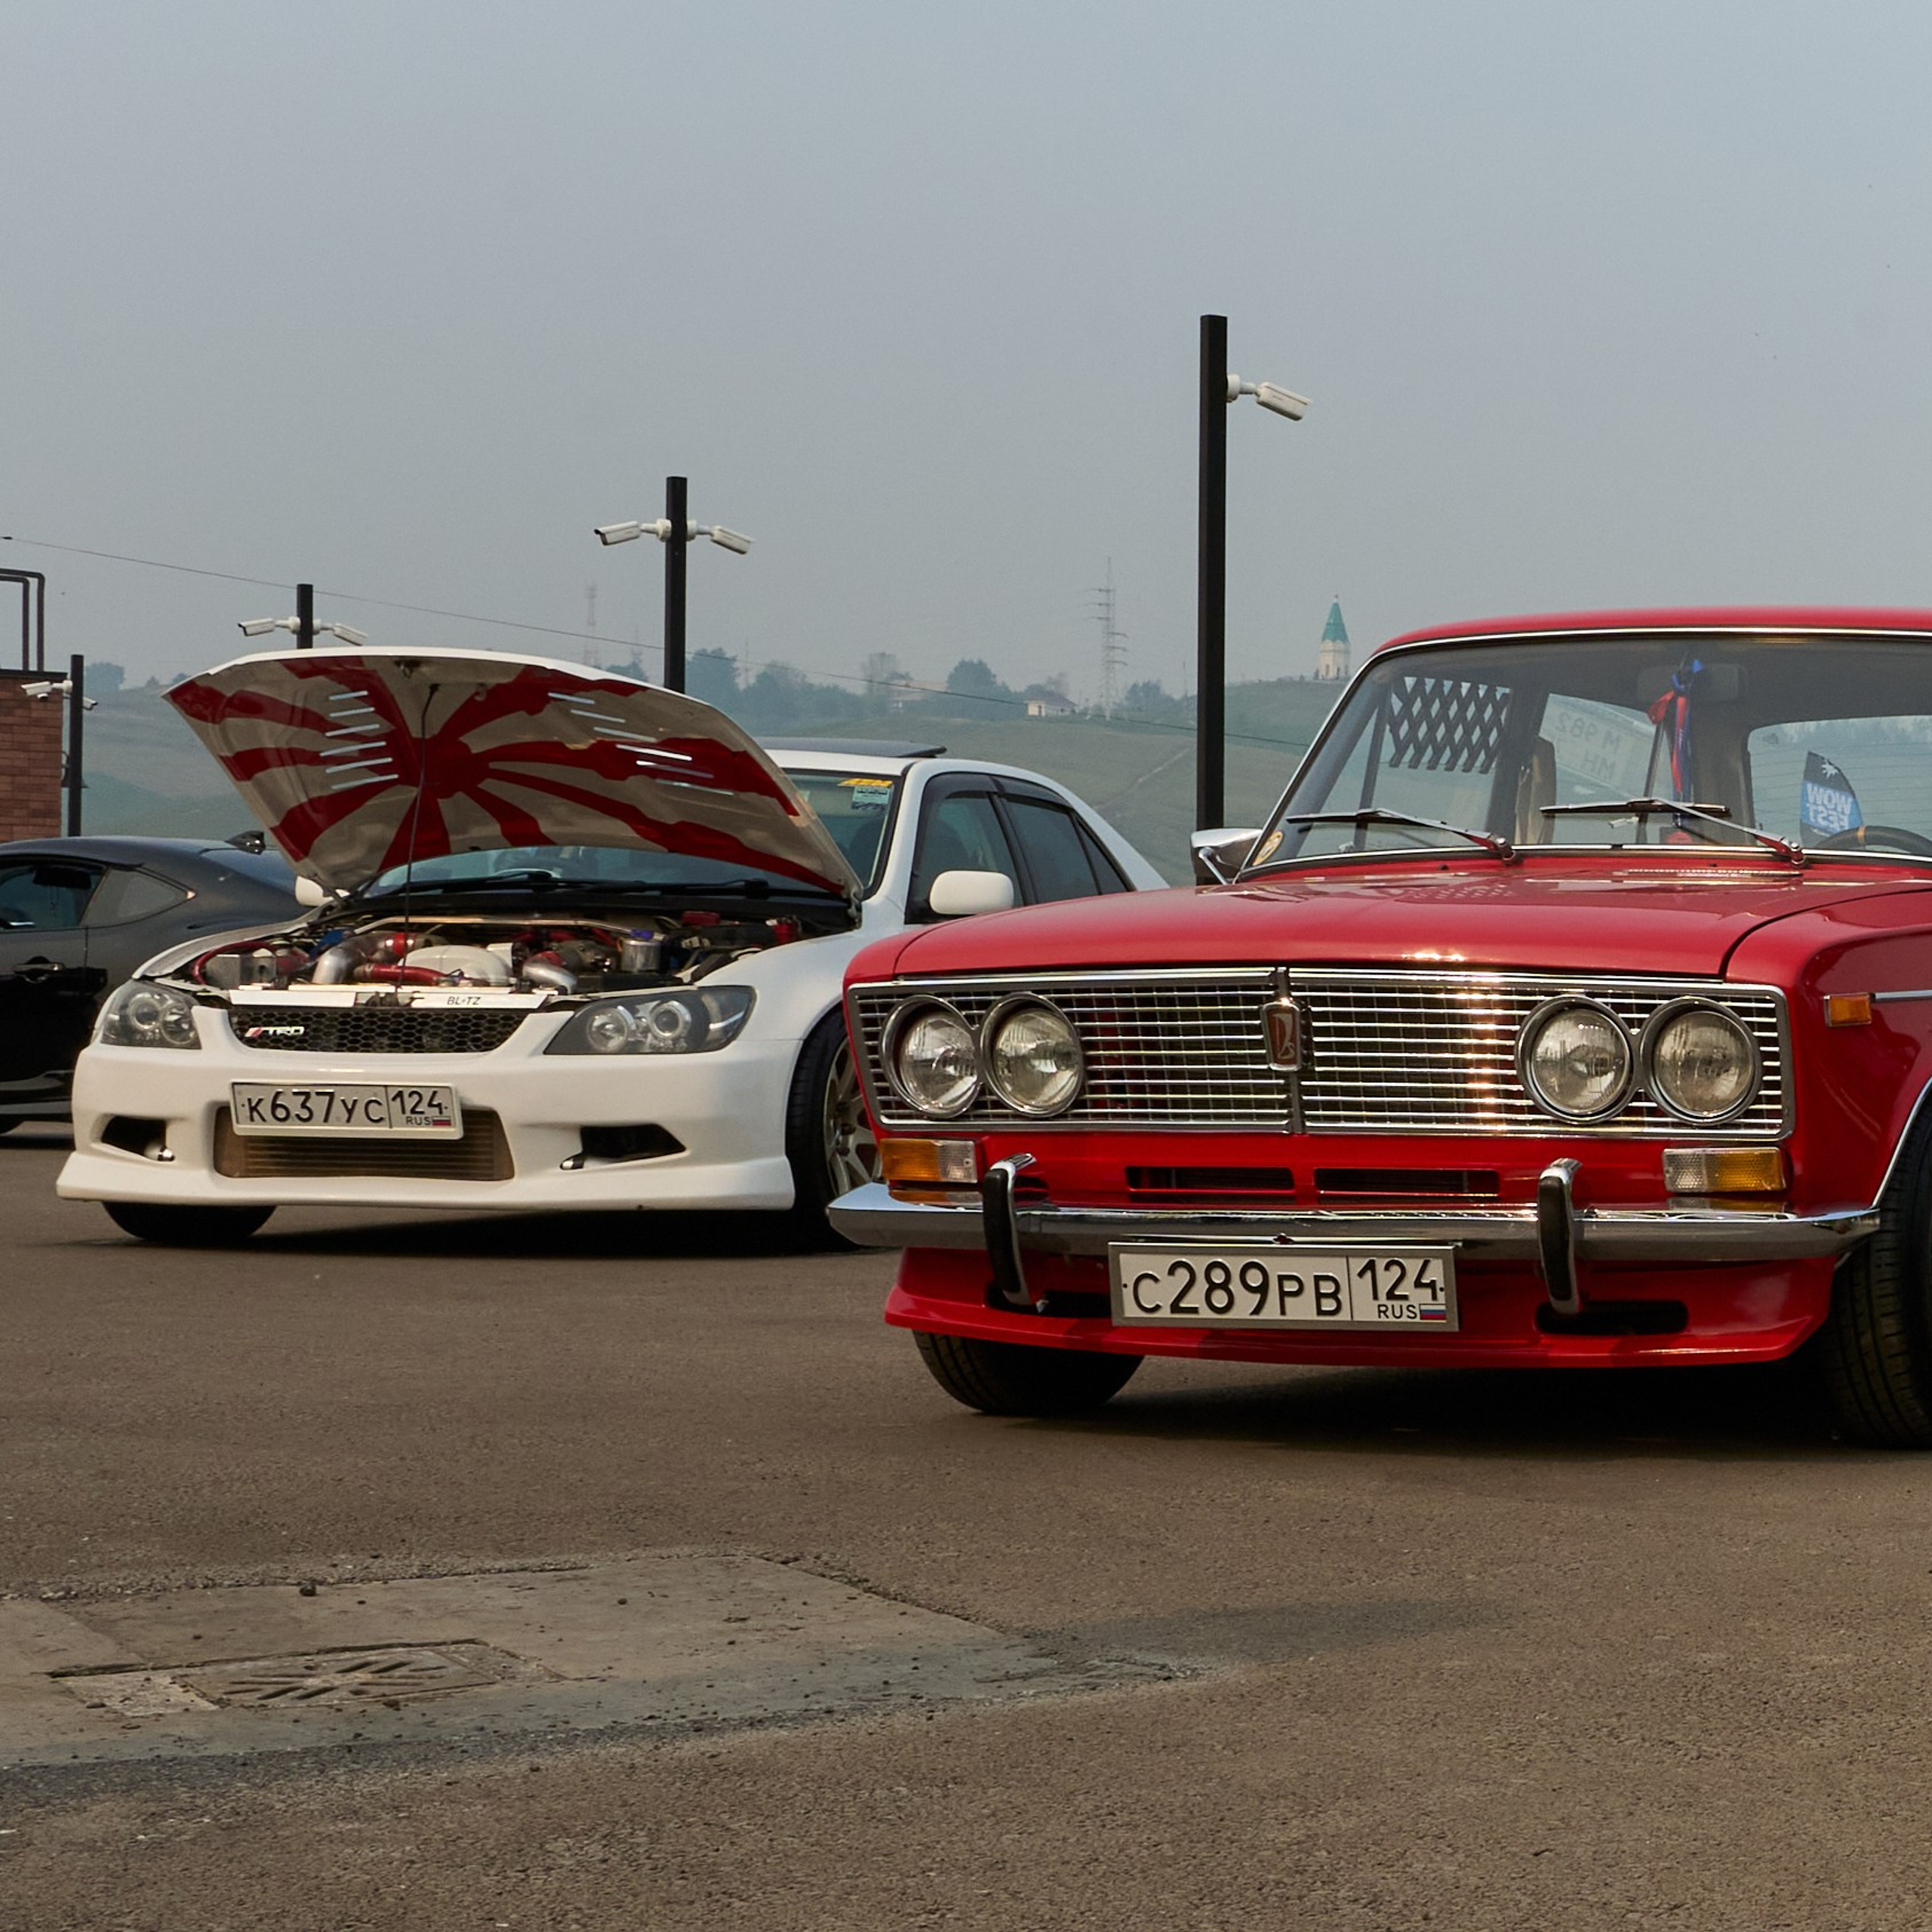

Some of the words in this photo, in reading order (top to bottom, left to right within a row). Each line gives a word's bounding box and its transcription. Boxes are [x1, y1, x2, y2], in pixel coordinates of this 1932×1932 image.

[260, 1026, 305, 1036] TRD
[391, 1090, 443, 1115] 124
[405, 1116, 432, 1126] RUS
[1356, 1258, 1438, 1302] 124
[1377, 1303, 1418, 1320] RUS
